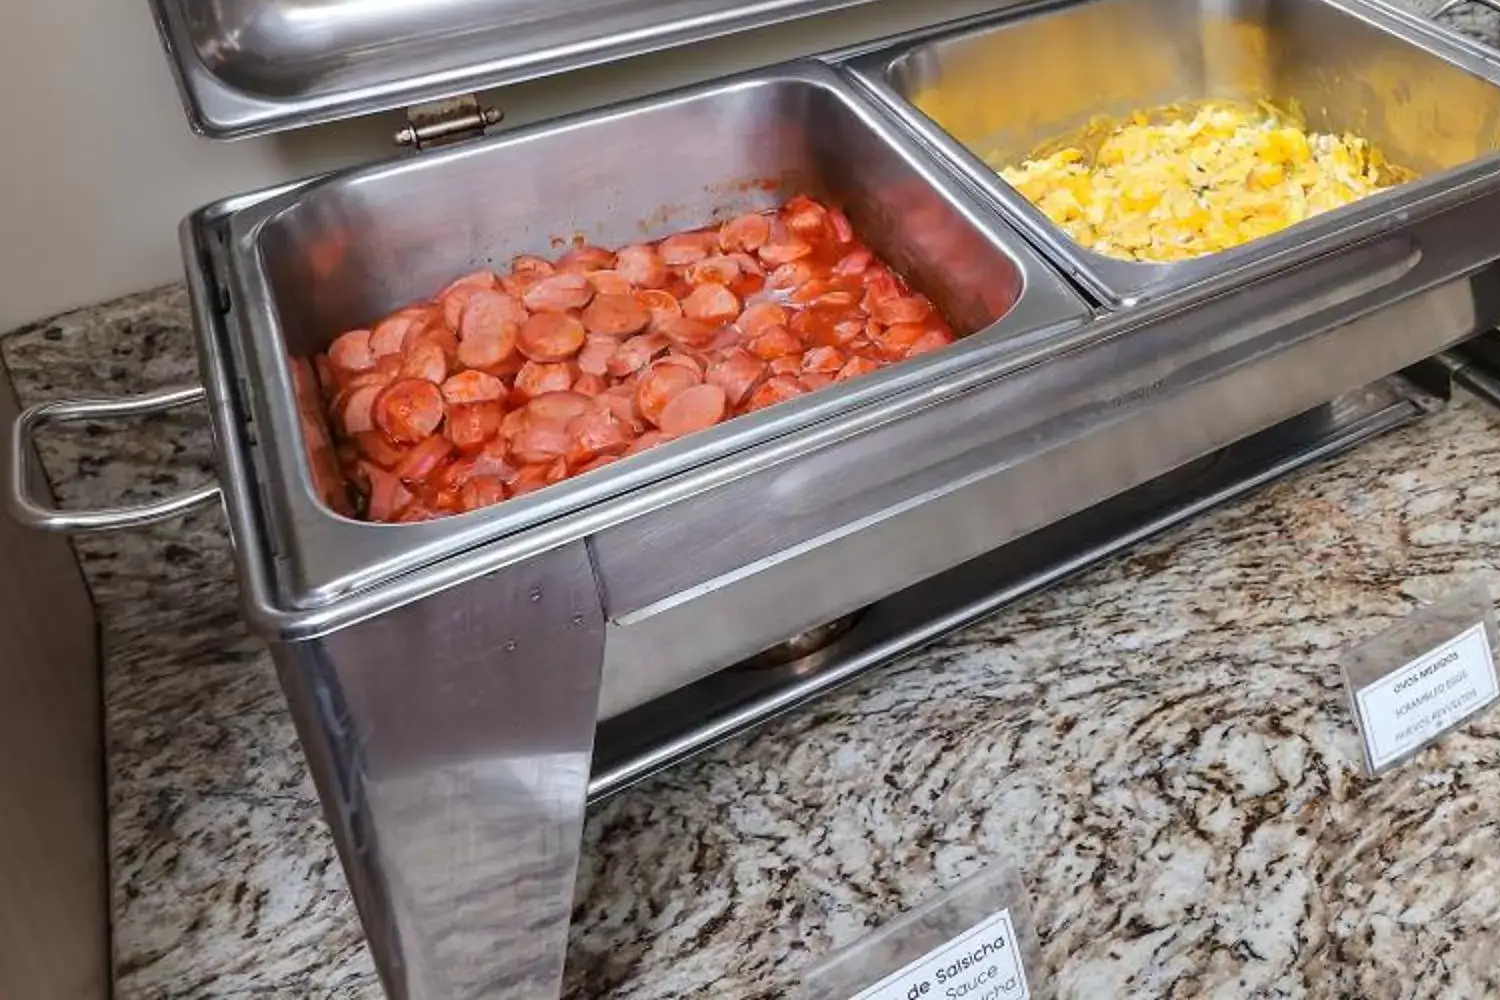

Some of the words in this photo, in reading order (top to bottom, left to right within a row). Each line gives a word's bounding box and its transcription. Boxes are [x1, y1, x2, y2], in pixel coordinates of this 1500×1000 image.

[907, 981, 931, 1000] de
[935, 936, 1005, 984] Salsicha
[945, 965, 998, 1000] Sauce
